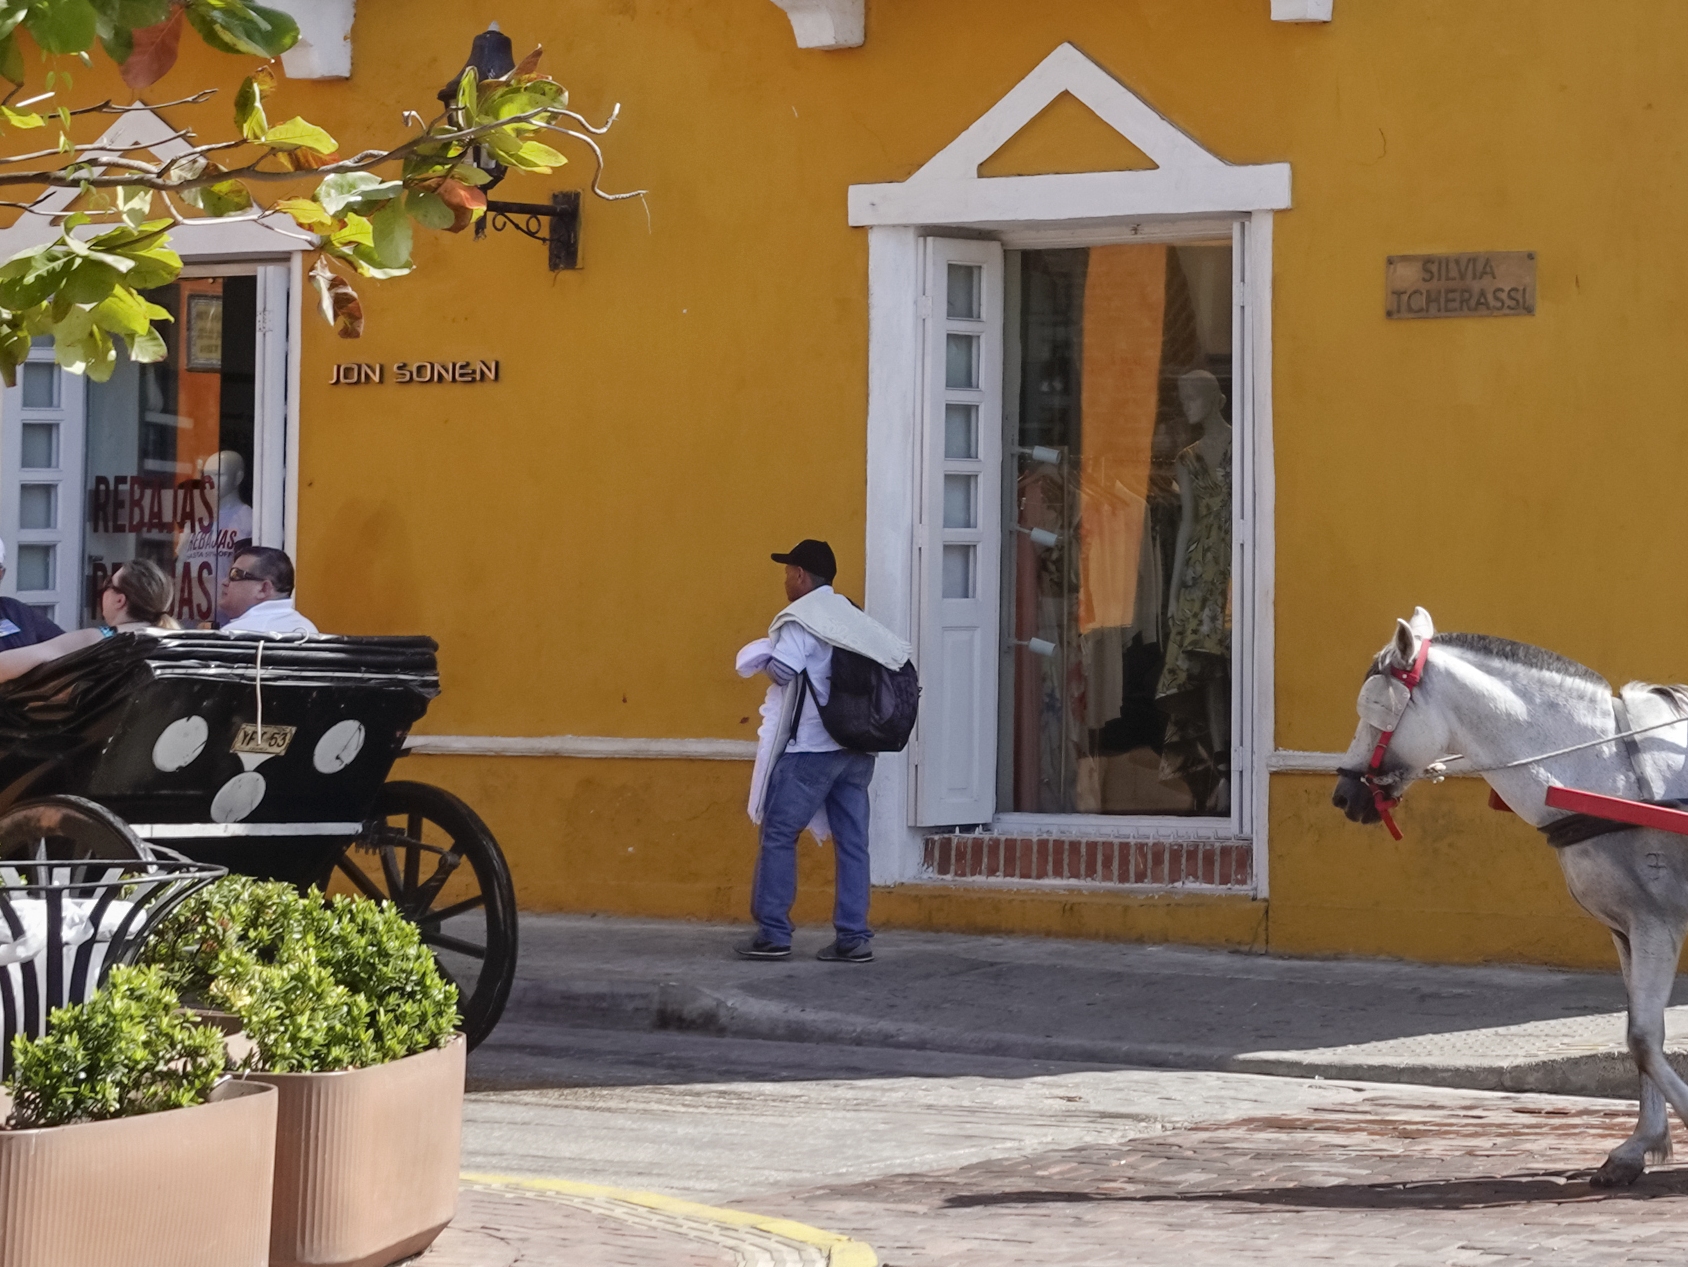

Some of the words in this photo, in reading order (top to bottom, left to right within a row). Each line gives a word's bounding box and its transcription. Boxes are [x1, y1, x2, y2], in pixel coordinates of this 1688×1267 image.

[1422, 257, 1496, 282] SILVIA
[1391, 286, 1527, 314] TCHERASSI
[329, 363, 382, 385] JON
[393, 360, 499, 383] SONEN
[93, 475, 215, 533] REBAJAS
[187, 529, 237, 551] REBAJAS
[268, 732, 288, 748] 53
